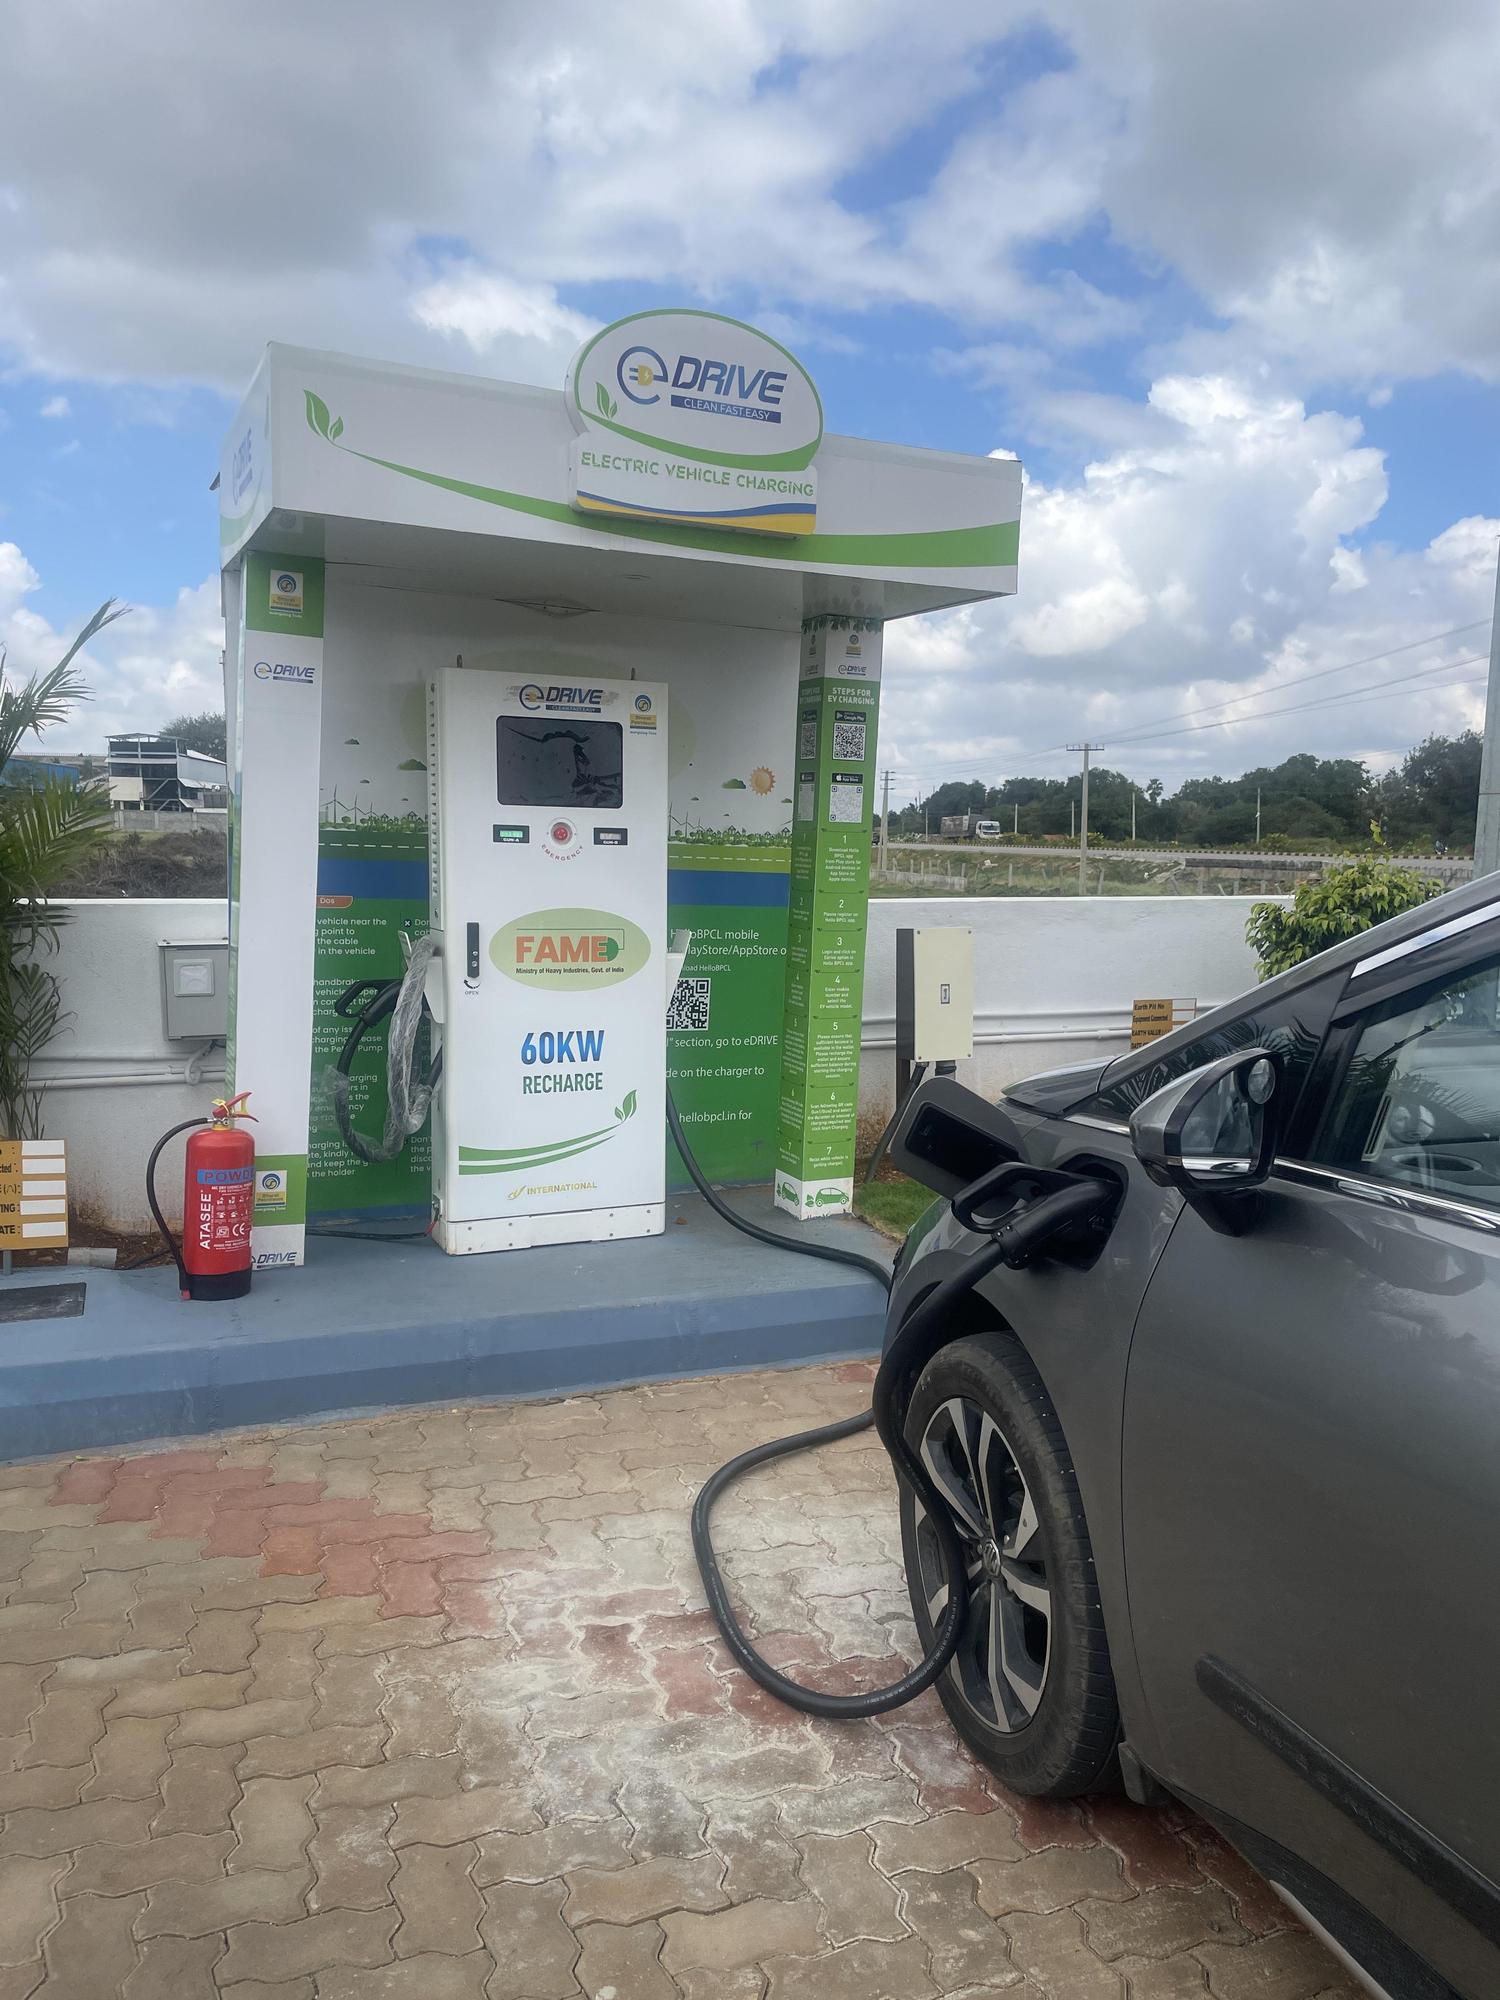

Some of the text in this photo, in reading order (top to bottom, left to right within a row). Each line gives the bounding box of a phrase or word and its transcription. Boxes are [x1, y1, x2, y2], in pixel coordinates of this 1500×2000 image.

[832, 687, 871, 697] STEPS FOR
[838, 695, 875, 705] CHARGING
[541, 844, 584, 861] EMERGENCY
[839, 899, 844, 909] 2
[317, 917, 348, 925] vehicle
[321, 928, 344, 937] point
[725, 929, 760, 940] mobile
[837, 936, 843, 946] 3
[328, 947, 343, 955] the
[344, 947, 376, 955] vehicle
[516, 935, 608, 963] FAME
[515, 968, 538, 976] Ministry
[835, 975, 840, 984] 4
[832, 1021, 838, 1031] 5
[322, 1027, 340, 1036] any
[520, 1029, 605, 1065] 60KW
[675, 1035, 779, 1049] section, go to eDRIVE
[315, 1045, 329, 1053] the
[357, 1045, 383, 1053] Pump
[680, 1070, 694, 1078] on
[696, 1067, 713, 1077] the
[714, 1066, 753, 1078] charger
[754, 1066, 765, 1076] to
[522, 1072, 603, 1095] RECHARGE
[355, 1092, 369, 1100] the
[830, 1091, 836, 1100] 6
[679, 1110, 753, 1123] hellobpcl.in for
[323, 1149, 349, 1158] kindly
[826, 1146, 832, 1155] 7
[323, 1160, 345, 1170] keep
[347, 1158, 360, 1166] the
[312, 1169, 356, 1178] the holder
[527, 1181, 598, 1196] INTERNATIONAL
[199, 1193, 212, 1250] ATASEE
